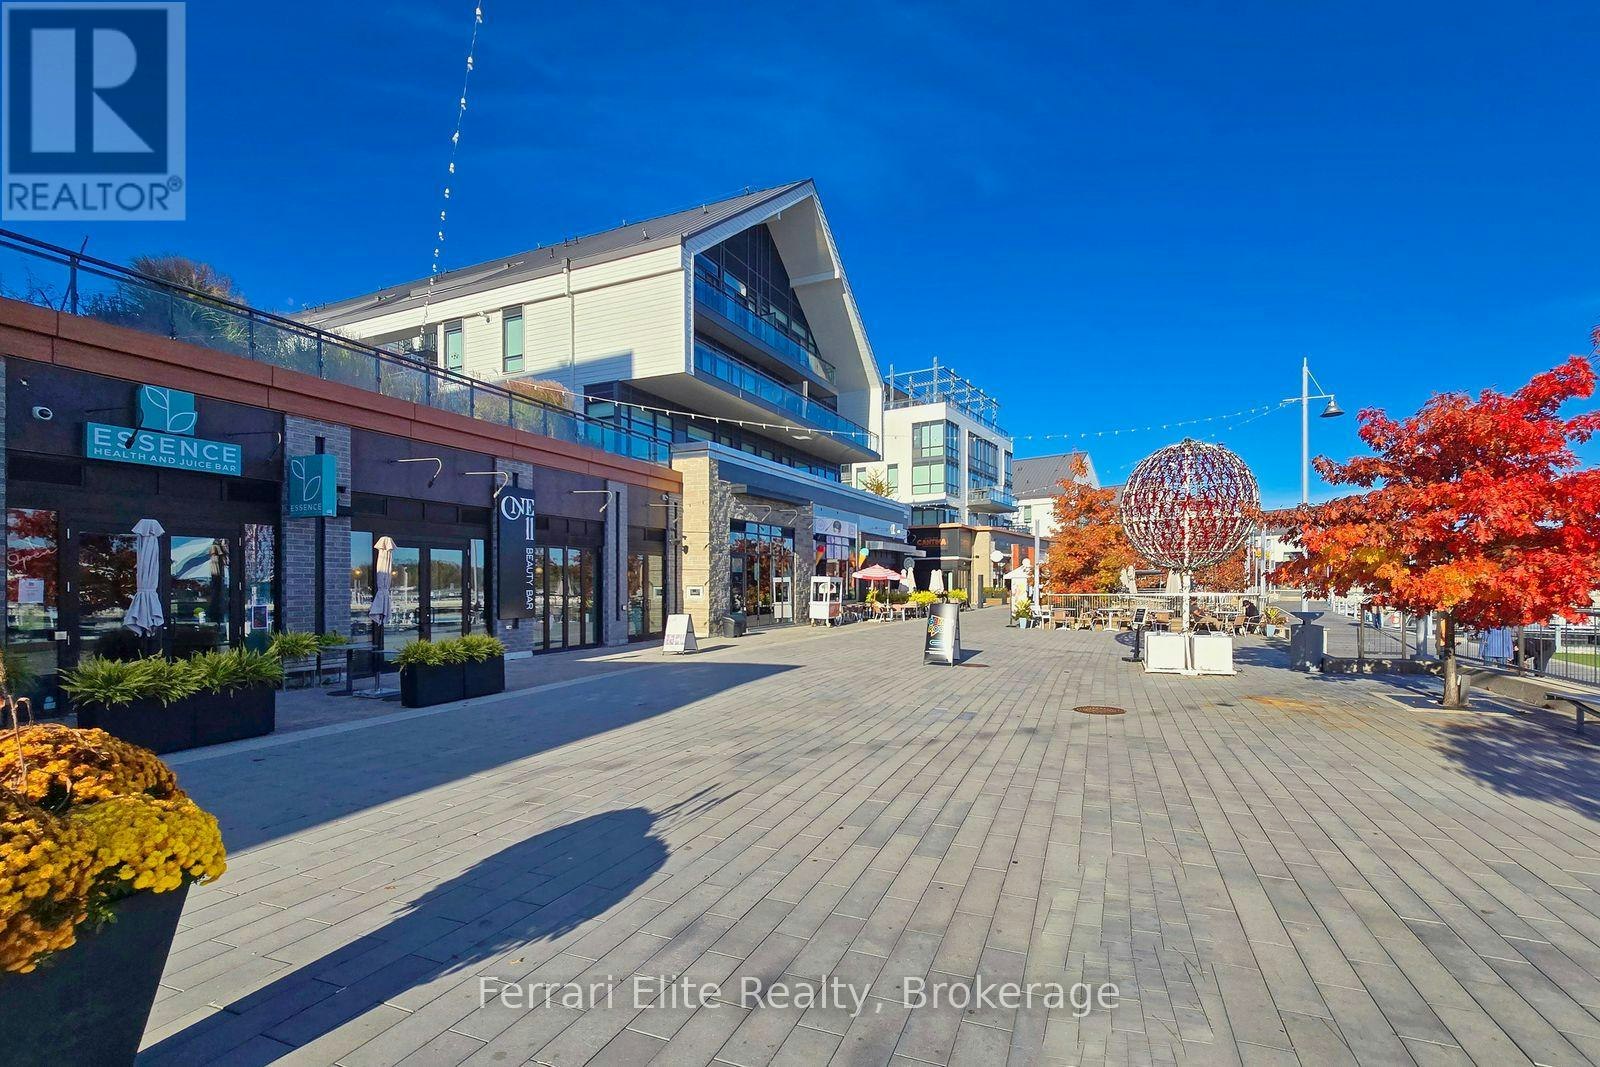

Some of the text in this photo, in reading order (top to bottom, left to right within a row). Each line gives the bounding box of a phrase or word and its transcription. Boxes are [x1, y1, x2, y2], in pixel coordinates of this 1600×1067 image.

[93, 427, 237, 463] ESSENCE
[93, 447, 236, 472] HEALTH AND JUICE BAR
[290, 503, 322, 512] ESSENCE
[501, 496, 535, 520] ONE
[525, 547, 534, 610] BEAUTY BAR
